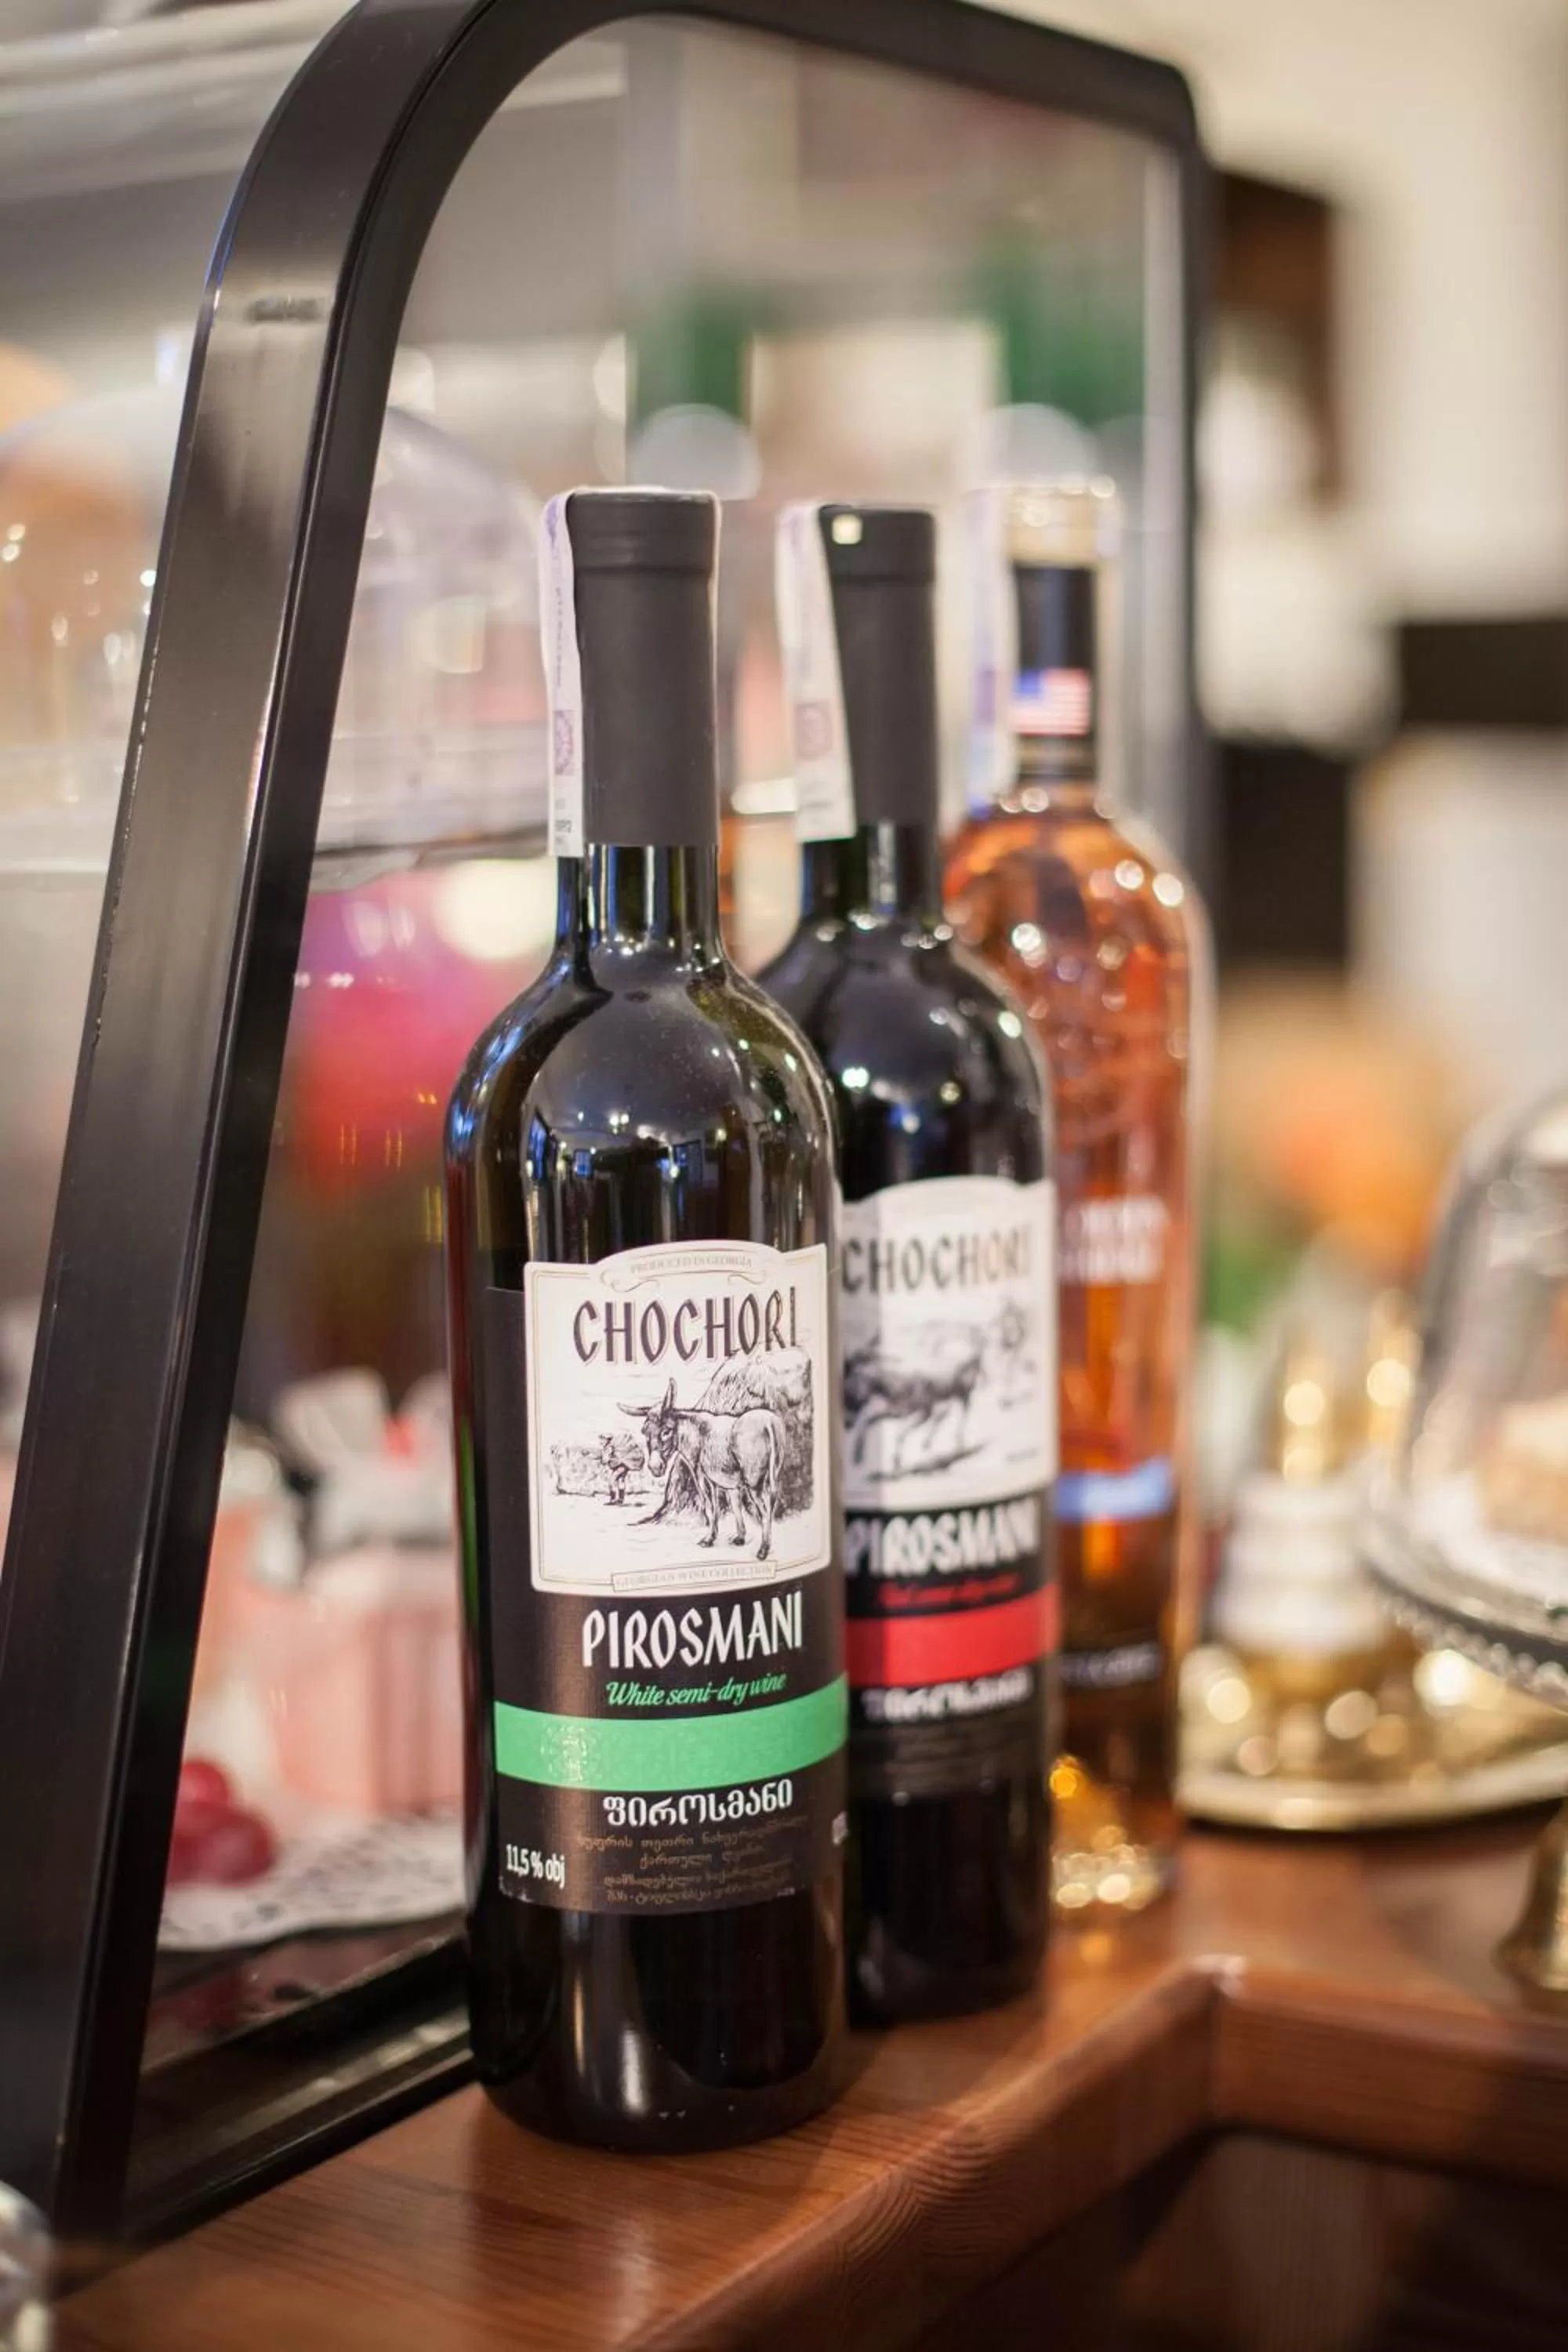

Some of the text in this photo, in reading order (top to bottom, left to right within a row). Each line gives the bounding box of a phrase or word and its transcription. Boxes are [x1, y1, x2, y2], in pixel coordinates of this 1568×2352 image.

[706, 1254, 753, 1269] GEORGIA
[573, 1286, 797, 1363] CHOCHORI
[582, 1591, 803, 1668] PIROSMANI
[606, 1672, 787, 1706] White semi-dry wine
[603, 1778, 793, 1828] ფიროსმანი
[545, 1853, 566, 1890] obj
